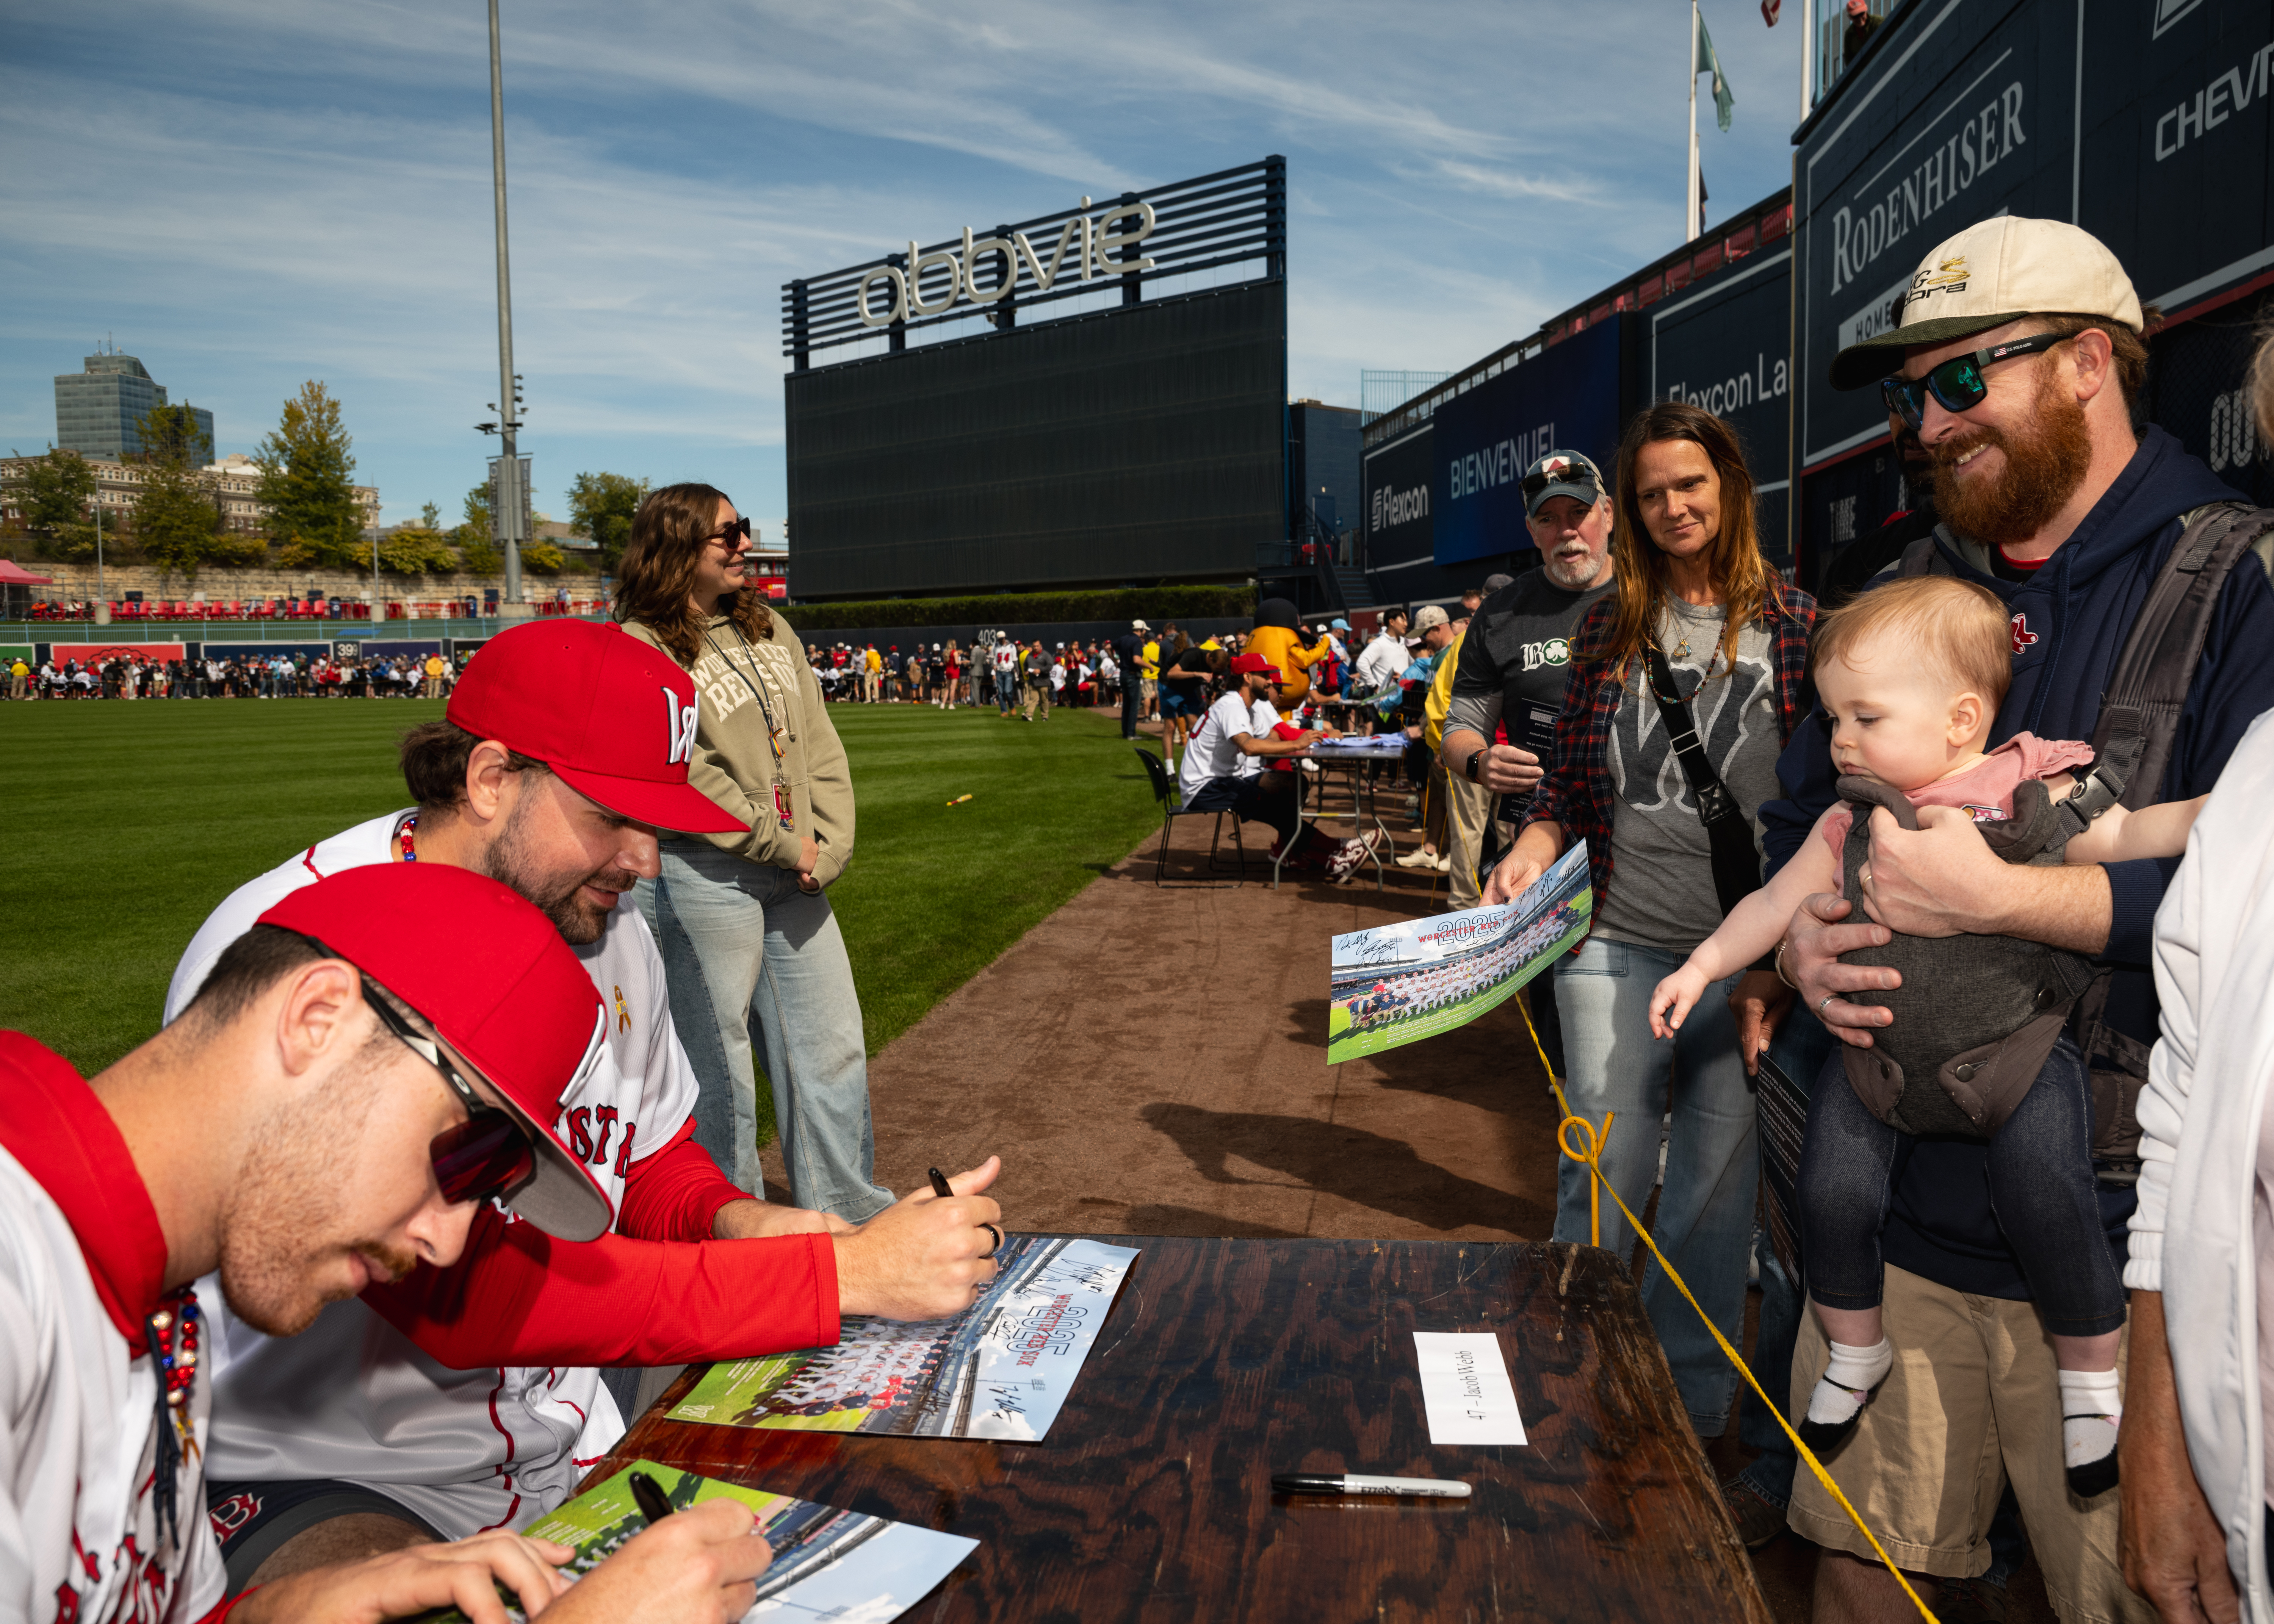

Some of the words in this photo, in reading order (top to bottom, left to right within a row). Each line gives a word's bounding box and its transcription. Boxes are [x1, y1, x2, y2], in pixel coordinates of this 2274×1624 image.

[1831, 81, 2026, 296] RODENHISER
[858, 196, 1155, 327] abbvie
[1758, 353, 1792, 401] La
[978, 629, 997, 645] 403
[997, 652, 1010, 664] 54
[1418, 925, 1475, 943] WORCESTER
[1481, 920, 1499, 931] RED
[1503, 908, 1519, 923] SOX
[1438, 910, 1505, 946] 2025
[1791, 1104, 1803, 1119] transformed
[1782, 1130, 1791, 1143] continued
[1037, 1293, 1074, 1332] WORCESTER
[1007, 1306, 1088, 1355] 2025
[1016, 1350, 1040, 1367] SOX
[1455, 1350, 1475, 1374] Webb
[1460, 1375, 1482, 1398] Jacob
[1467, 1410, 1486, 1420] 47
